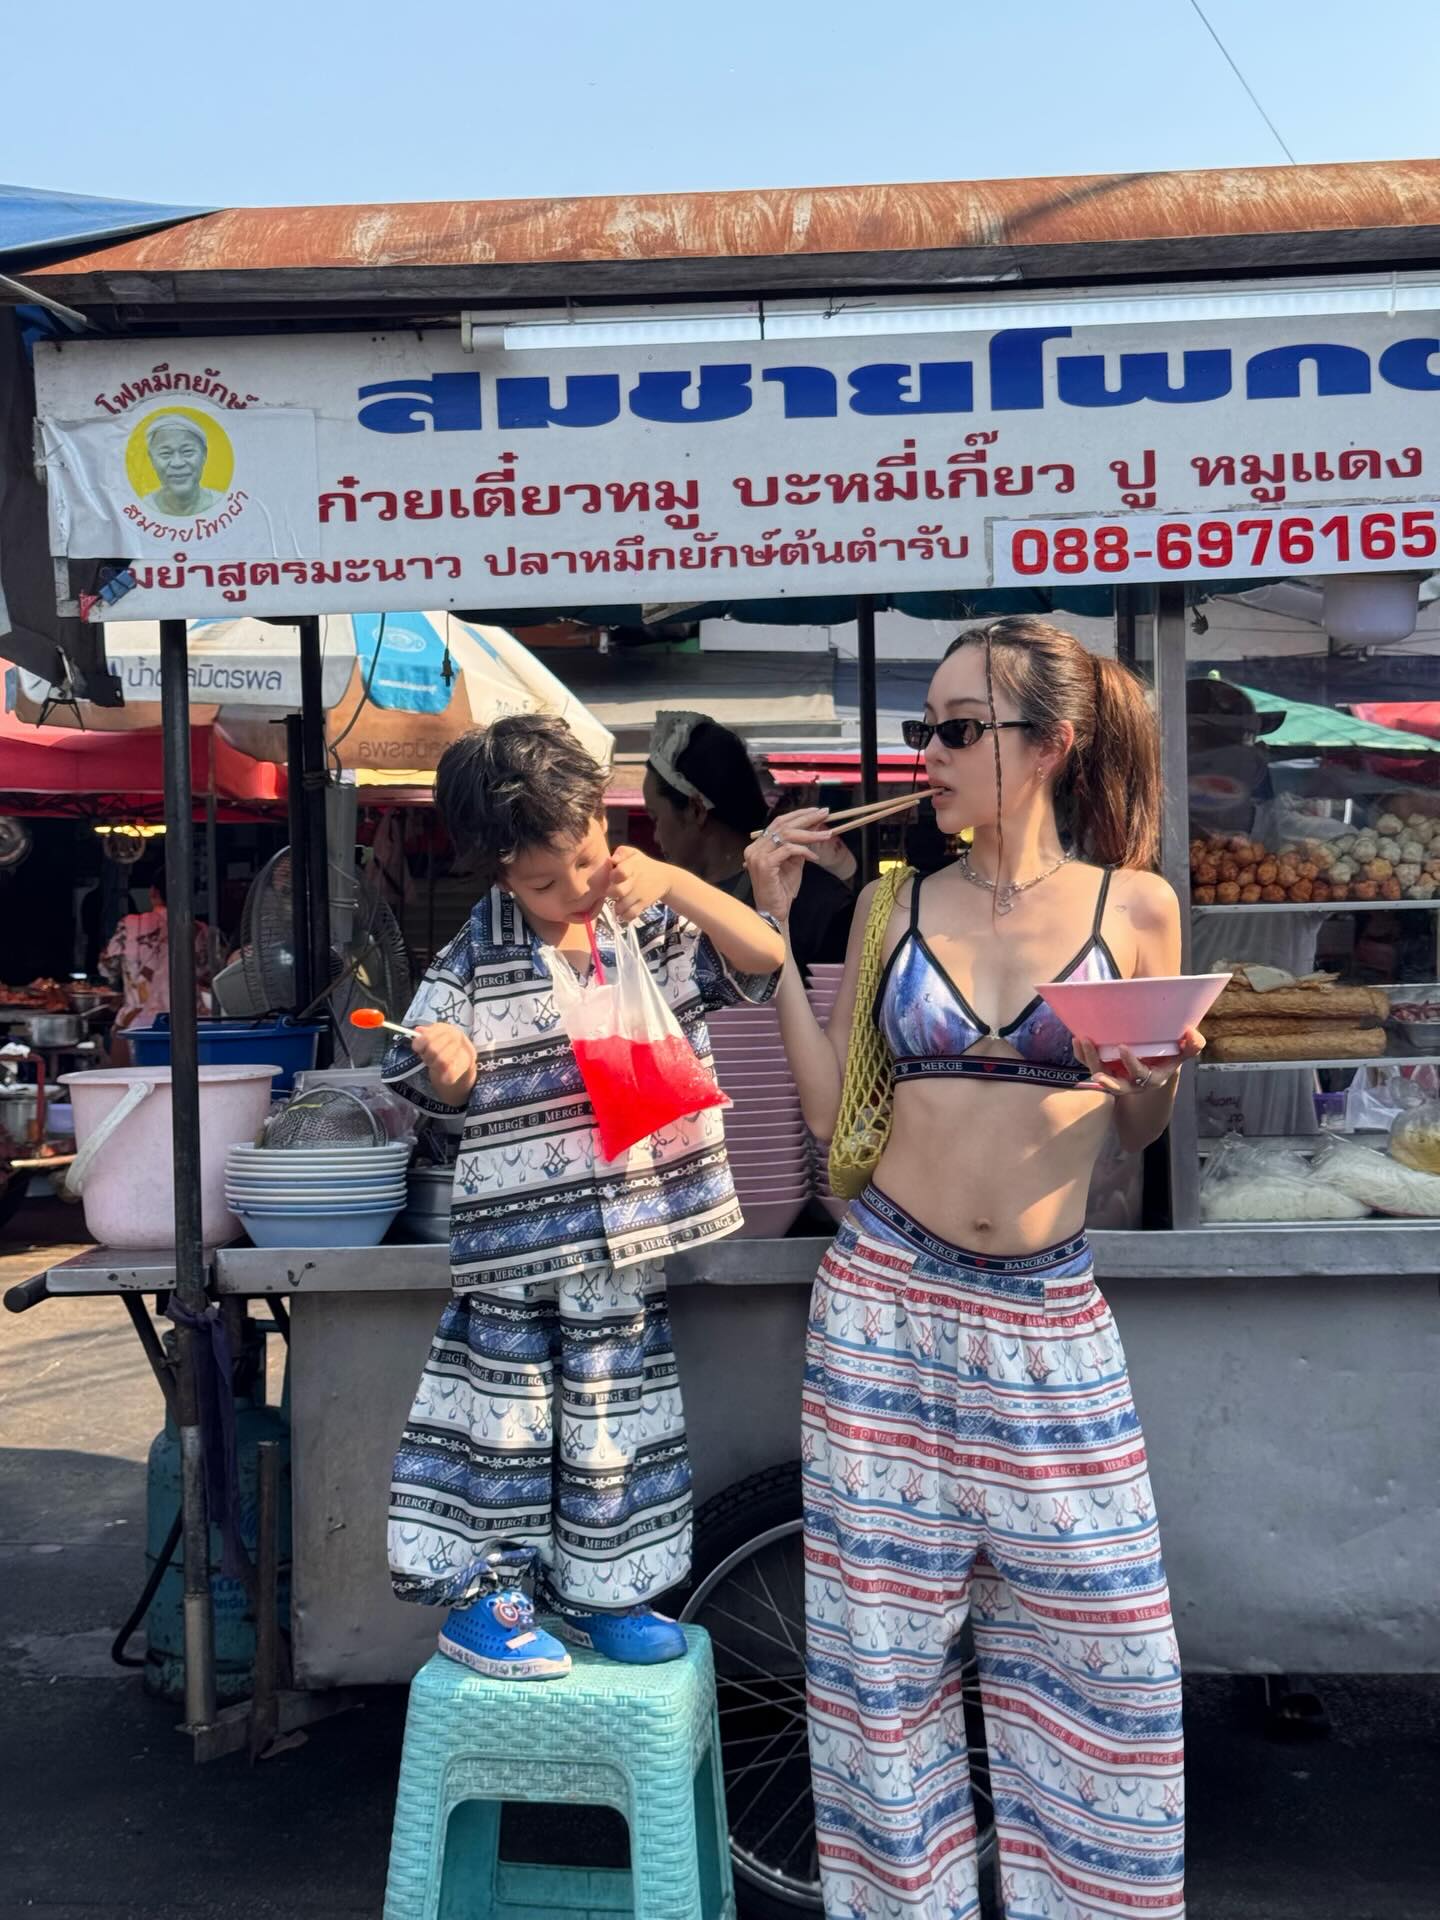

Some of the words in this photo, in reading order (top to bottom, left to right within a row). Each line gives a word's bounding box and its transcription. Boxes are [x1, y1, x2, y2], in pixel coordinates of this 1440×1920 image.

[318, 451, 700, 531] ก๋วยเตี๋ยวหมู
[733, 429, 1075, 507] บะหมี่เกี๊ยว
[1110, 449, 1157, 509] ปู
[1190, 444, 1423, 503] หมูแดง
[1011, 510, 1437, 576] 088-6976165
[128, 552, 462, 602] มยำสูตรมะนาว
[485, 525, 969, 577] ปลาหมึกยักษ์ต้นตำรับ
[128, 656, 283, 691] น้ำลมิตรพล
[921, 1062, 963, 1072] MERGE
[1017, 1066, 1080, 1082] BANGKOK
[488, 1117, 526, 1134] MERGE
[545, 1104, 585, 1123] MERGE
[640, 1236, 677, 1253] MERGE
[698, 1217, 732, 1237] MERGE
[863, 1188, 897, 1220] ANGKOK
[923, 1237, 960, 1261] MERGE
[1004, 1253, 1057, 1270] BANGKOK
[494, 1265, 528, 1282] MERGE
[550, 1252, 589, 1271] MERGE
[395, 1494, 432, 1511] MERGE
[493, 1517, 527, 1531] MERGE
